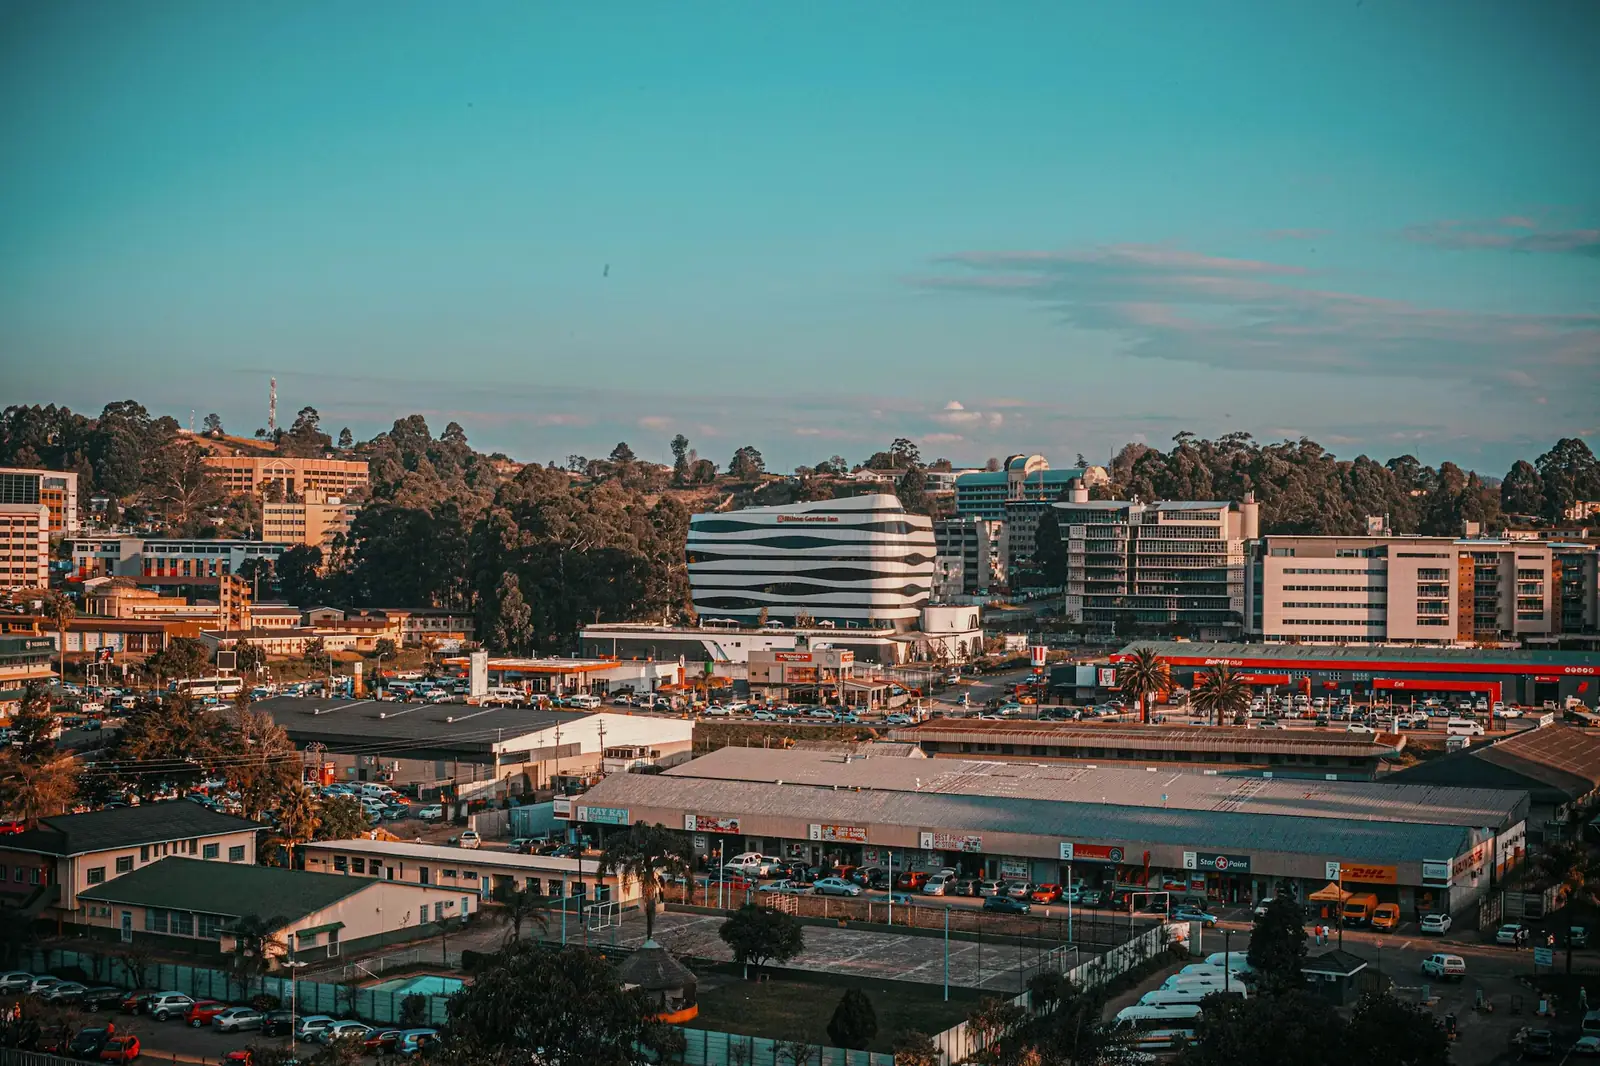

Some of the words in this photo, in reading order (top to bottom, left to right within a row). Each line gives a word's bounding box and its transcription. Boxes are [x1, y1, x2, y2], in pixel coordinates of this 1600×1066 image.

[589, 807, 607, 815] KAY
[609, 808, 628, 817] KAY
[688, 821, 693, 829] 2
[813, 831, 819, 839] 3
[934, 833, 949, 841] BEST
[924, 839, 930, 847] 4
[1063, 850, 1070, 858] 5
[1187, 859, 1193, 868] 6
[1229, 860, 1247, 868] Paint
[1329, 868, 1336, 878] 7
[1351, 868, 1387, 879] DHL
